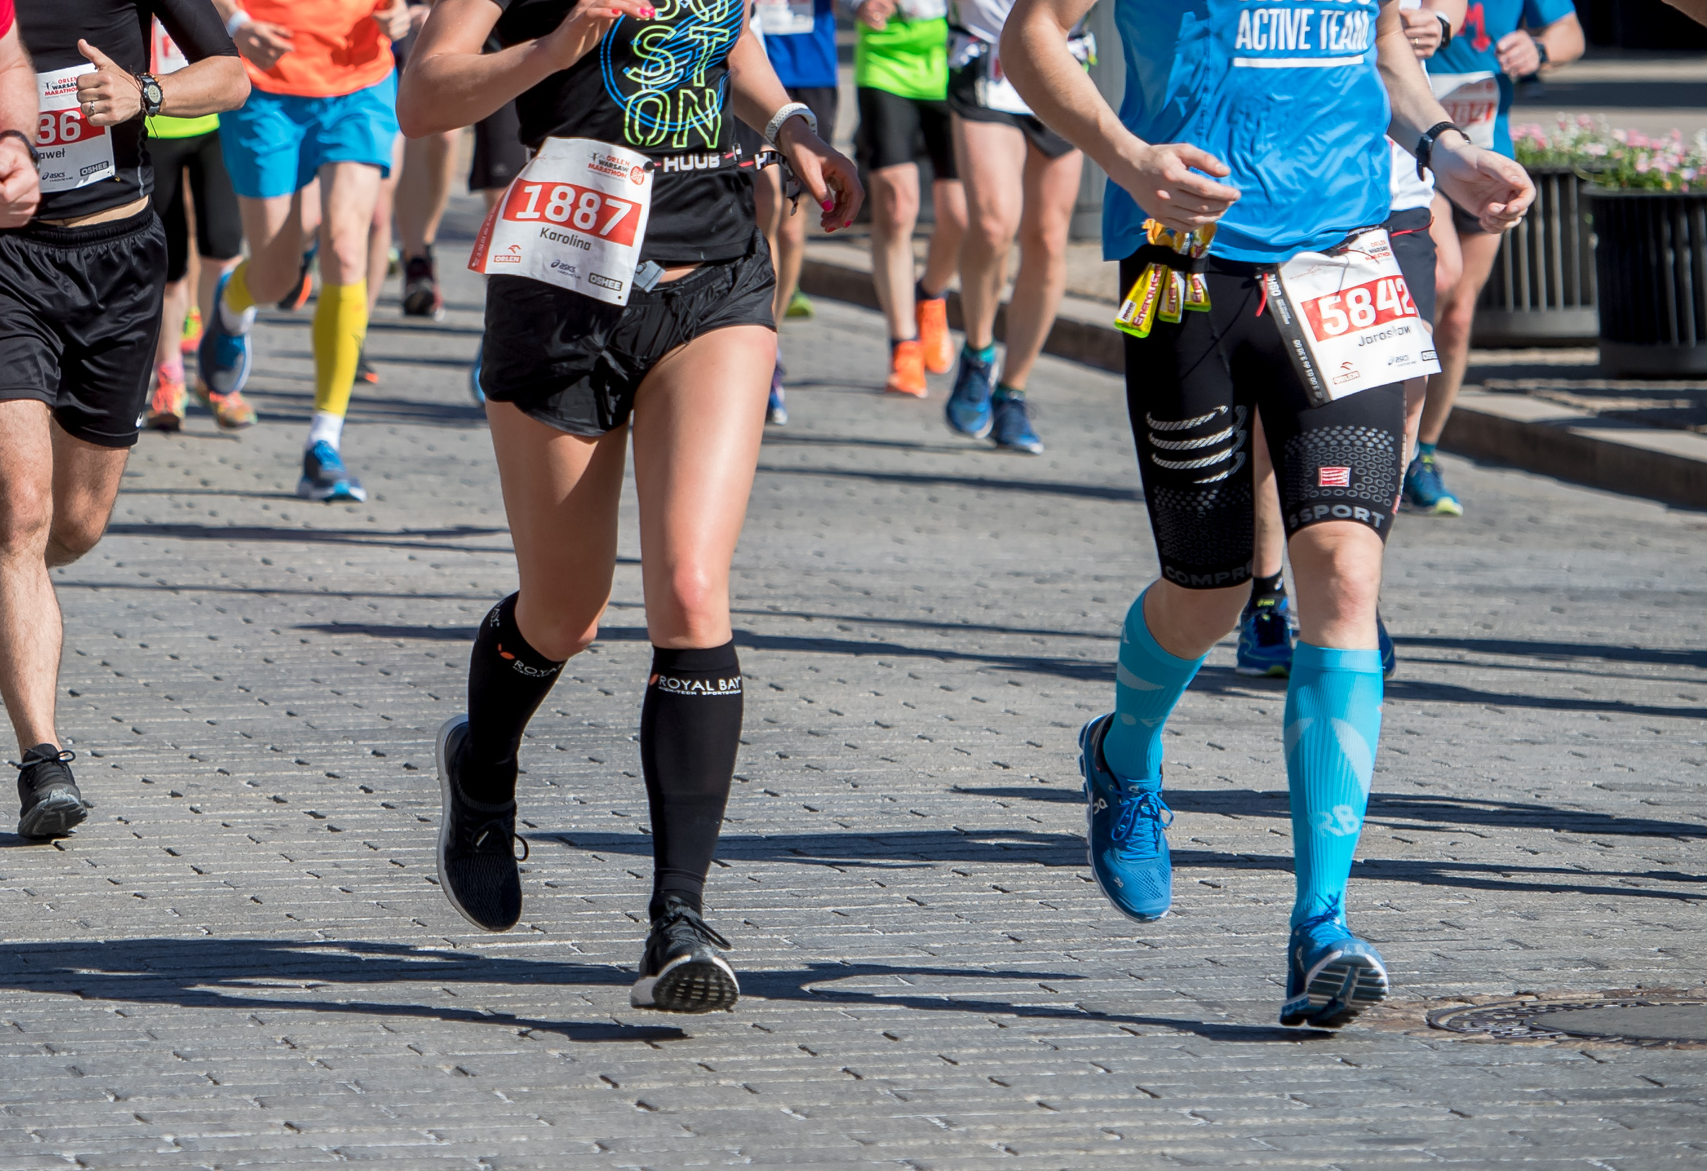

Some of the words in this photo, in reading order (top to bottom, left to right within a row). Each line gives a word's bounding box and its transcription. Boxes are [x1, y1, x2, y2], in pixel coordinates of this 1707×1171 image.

[1234, 8, 1315, 51] ACTIVE
[1319, 9, 1370, 50] TEAM
[38, 109, 81, 145] 36
[39, 148, 66, 160] aweł
[606, 155, 630, 166] ORLEN
[663, 152, 721, 173] HUUB
[81, 161, 108, 175] OSHEE
[587, 163, 627, 178] MARATHON
[598, 159, 629, 172] WARSAW
[515, 184, 632, 236] 1887
[539, 227, 592, 251] Karolina
[591, 275, 622, 291] OSHEE
[1268, 274, 1282, 297] OSH
[1317, 277, 1415, 336] 5842
[659, 675, 714, 691] ROYAL
[718, 676, 742, 690] BAY
